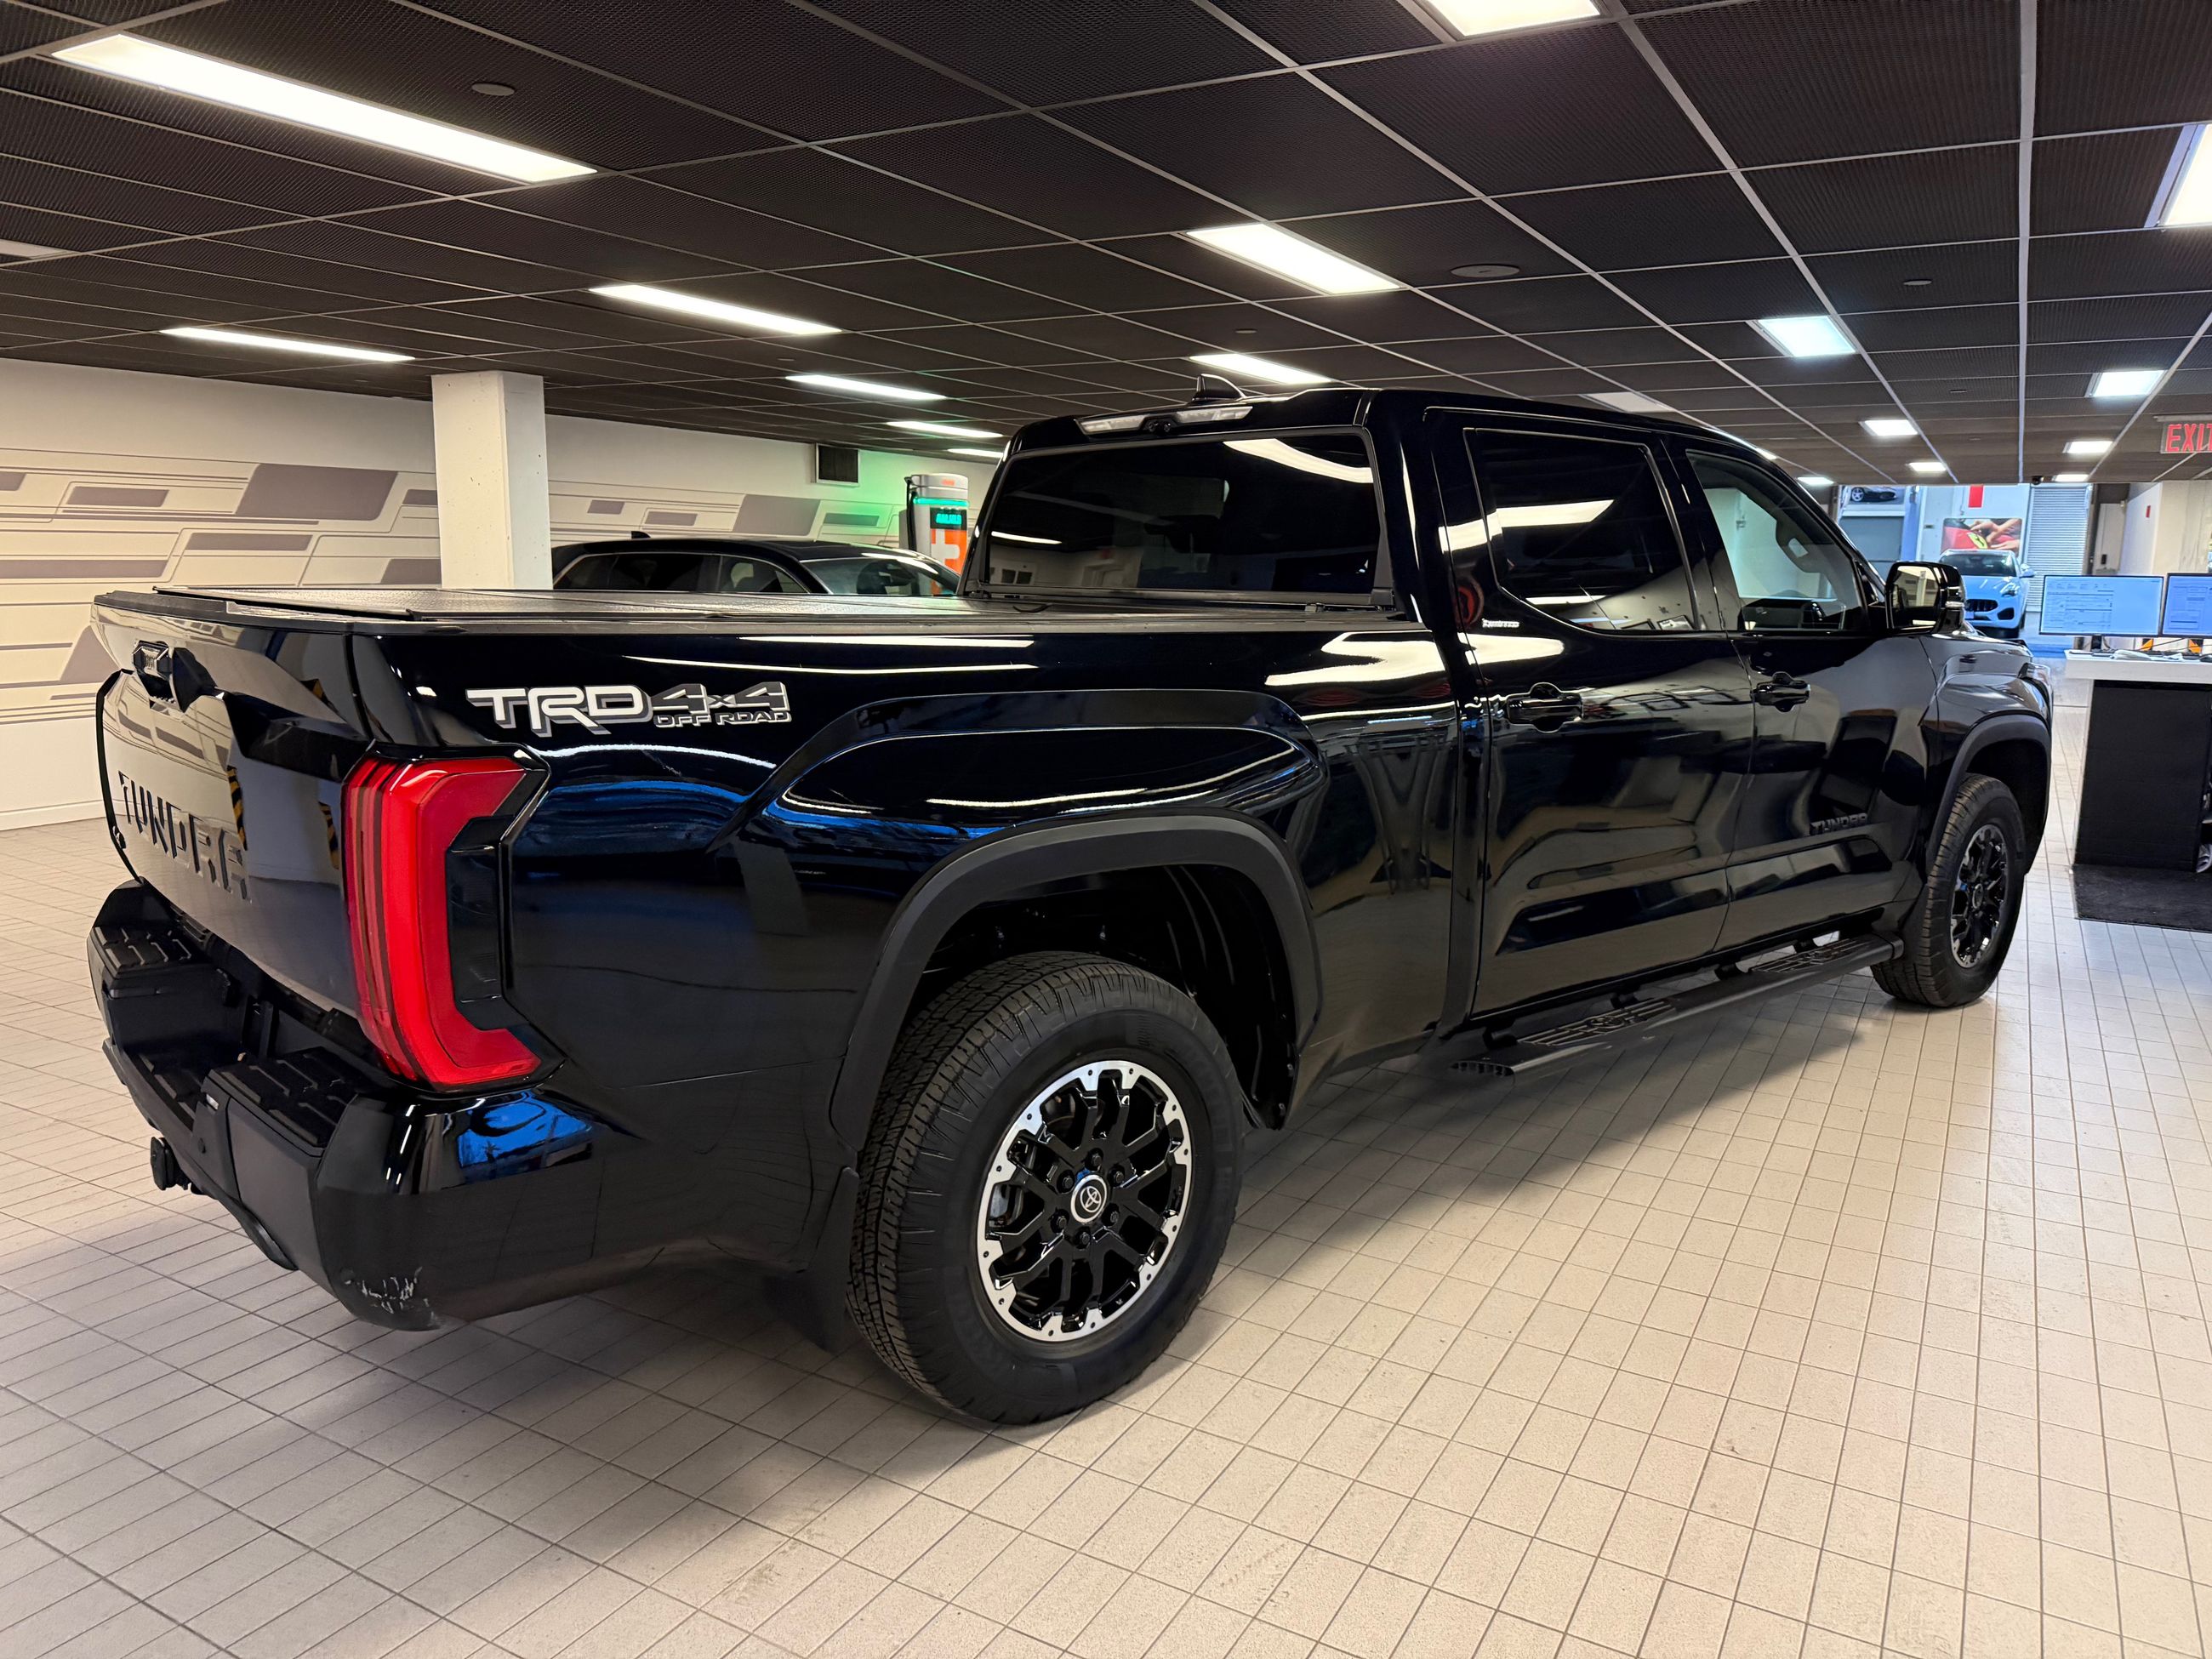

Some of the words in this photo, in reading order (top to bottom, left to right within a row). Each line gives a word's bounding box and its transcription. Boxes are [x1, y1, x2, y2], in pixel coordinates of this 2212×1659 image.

[465, 685, 653, 737] TRD
[651, 681, 790, 713] 4x4
[653, 713, 710, 727] OFF
[715, 710, 792, 726] ROAD
[117, 770, 250, 901] TUNDRA
